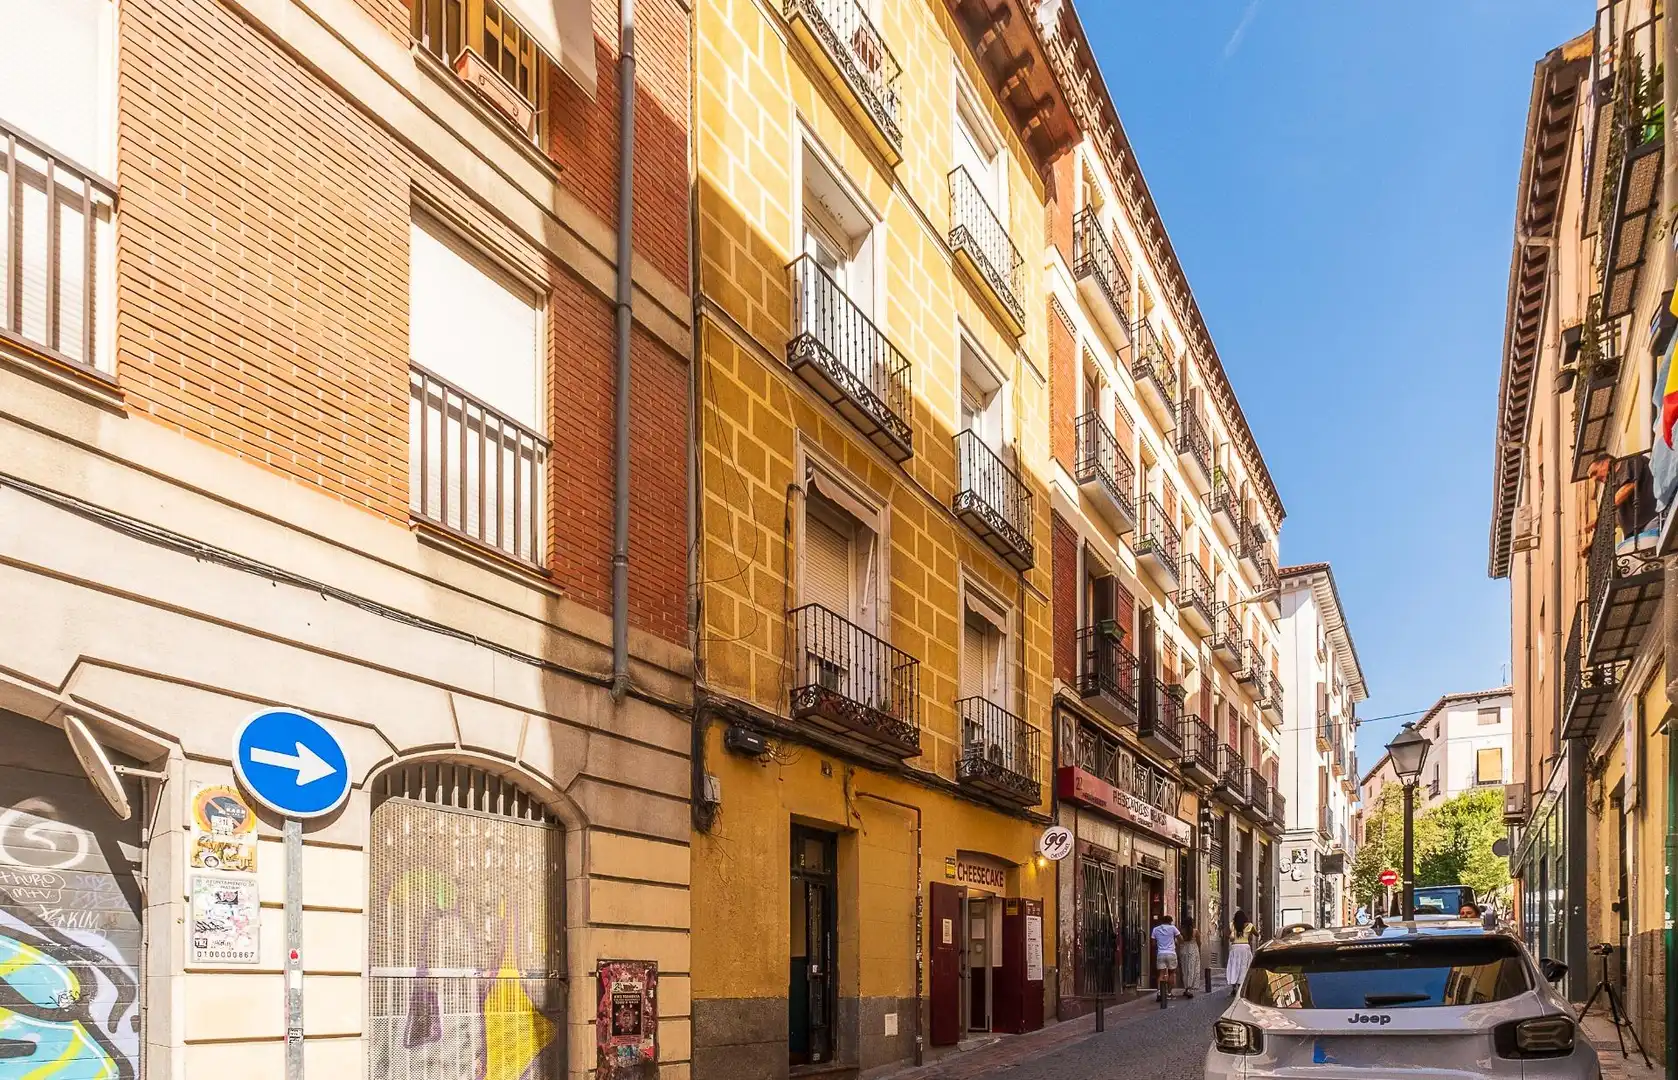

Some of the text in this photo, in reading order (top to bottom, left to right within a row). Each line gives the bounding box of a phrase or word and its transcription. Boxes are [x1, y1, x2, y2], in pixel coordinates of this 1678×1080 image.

[1044, 832, 1067, 851] 99
[956, 861, 1004, 888] CHEESECAKE
[197, 950, 255, 958] 0100000867
[1347, 1013, 1391, 1025] Jeep
